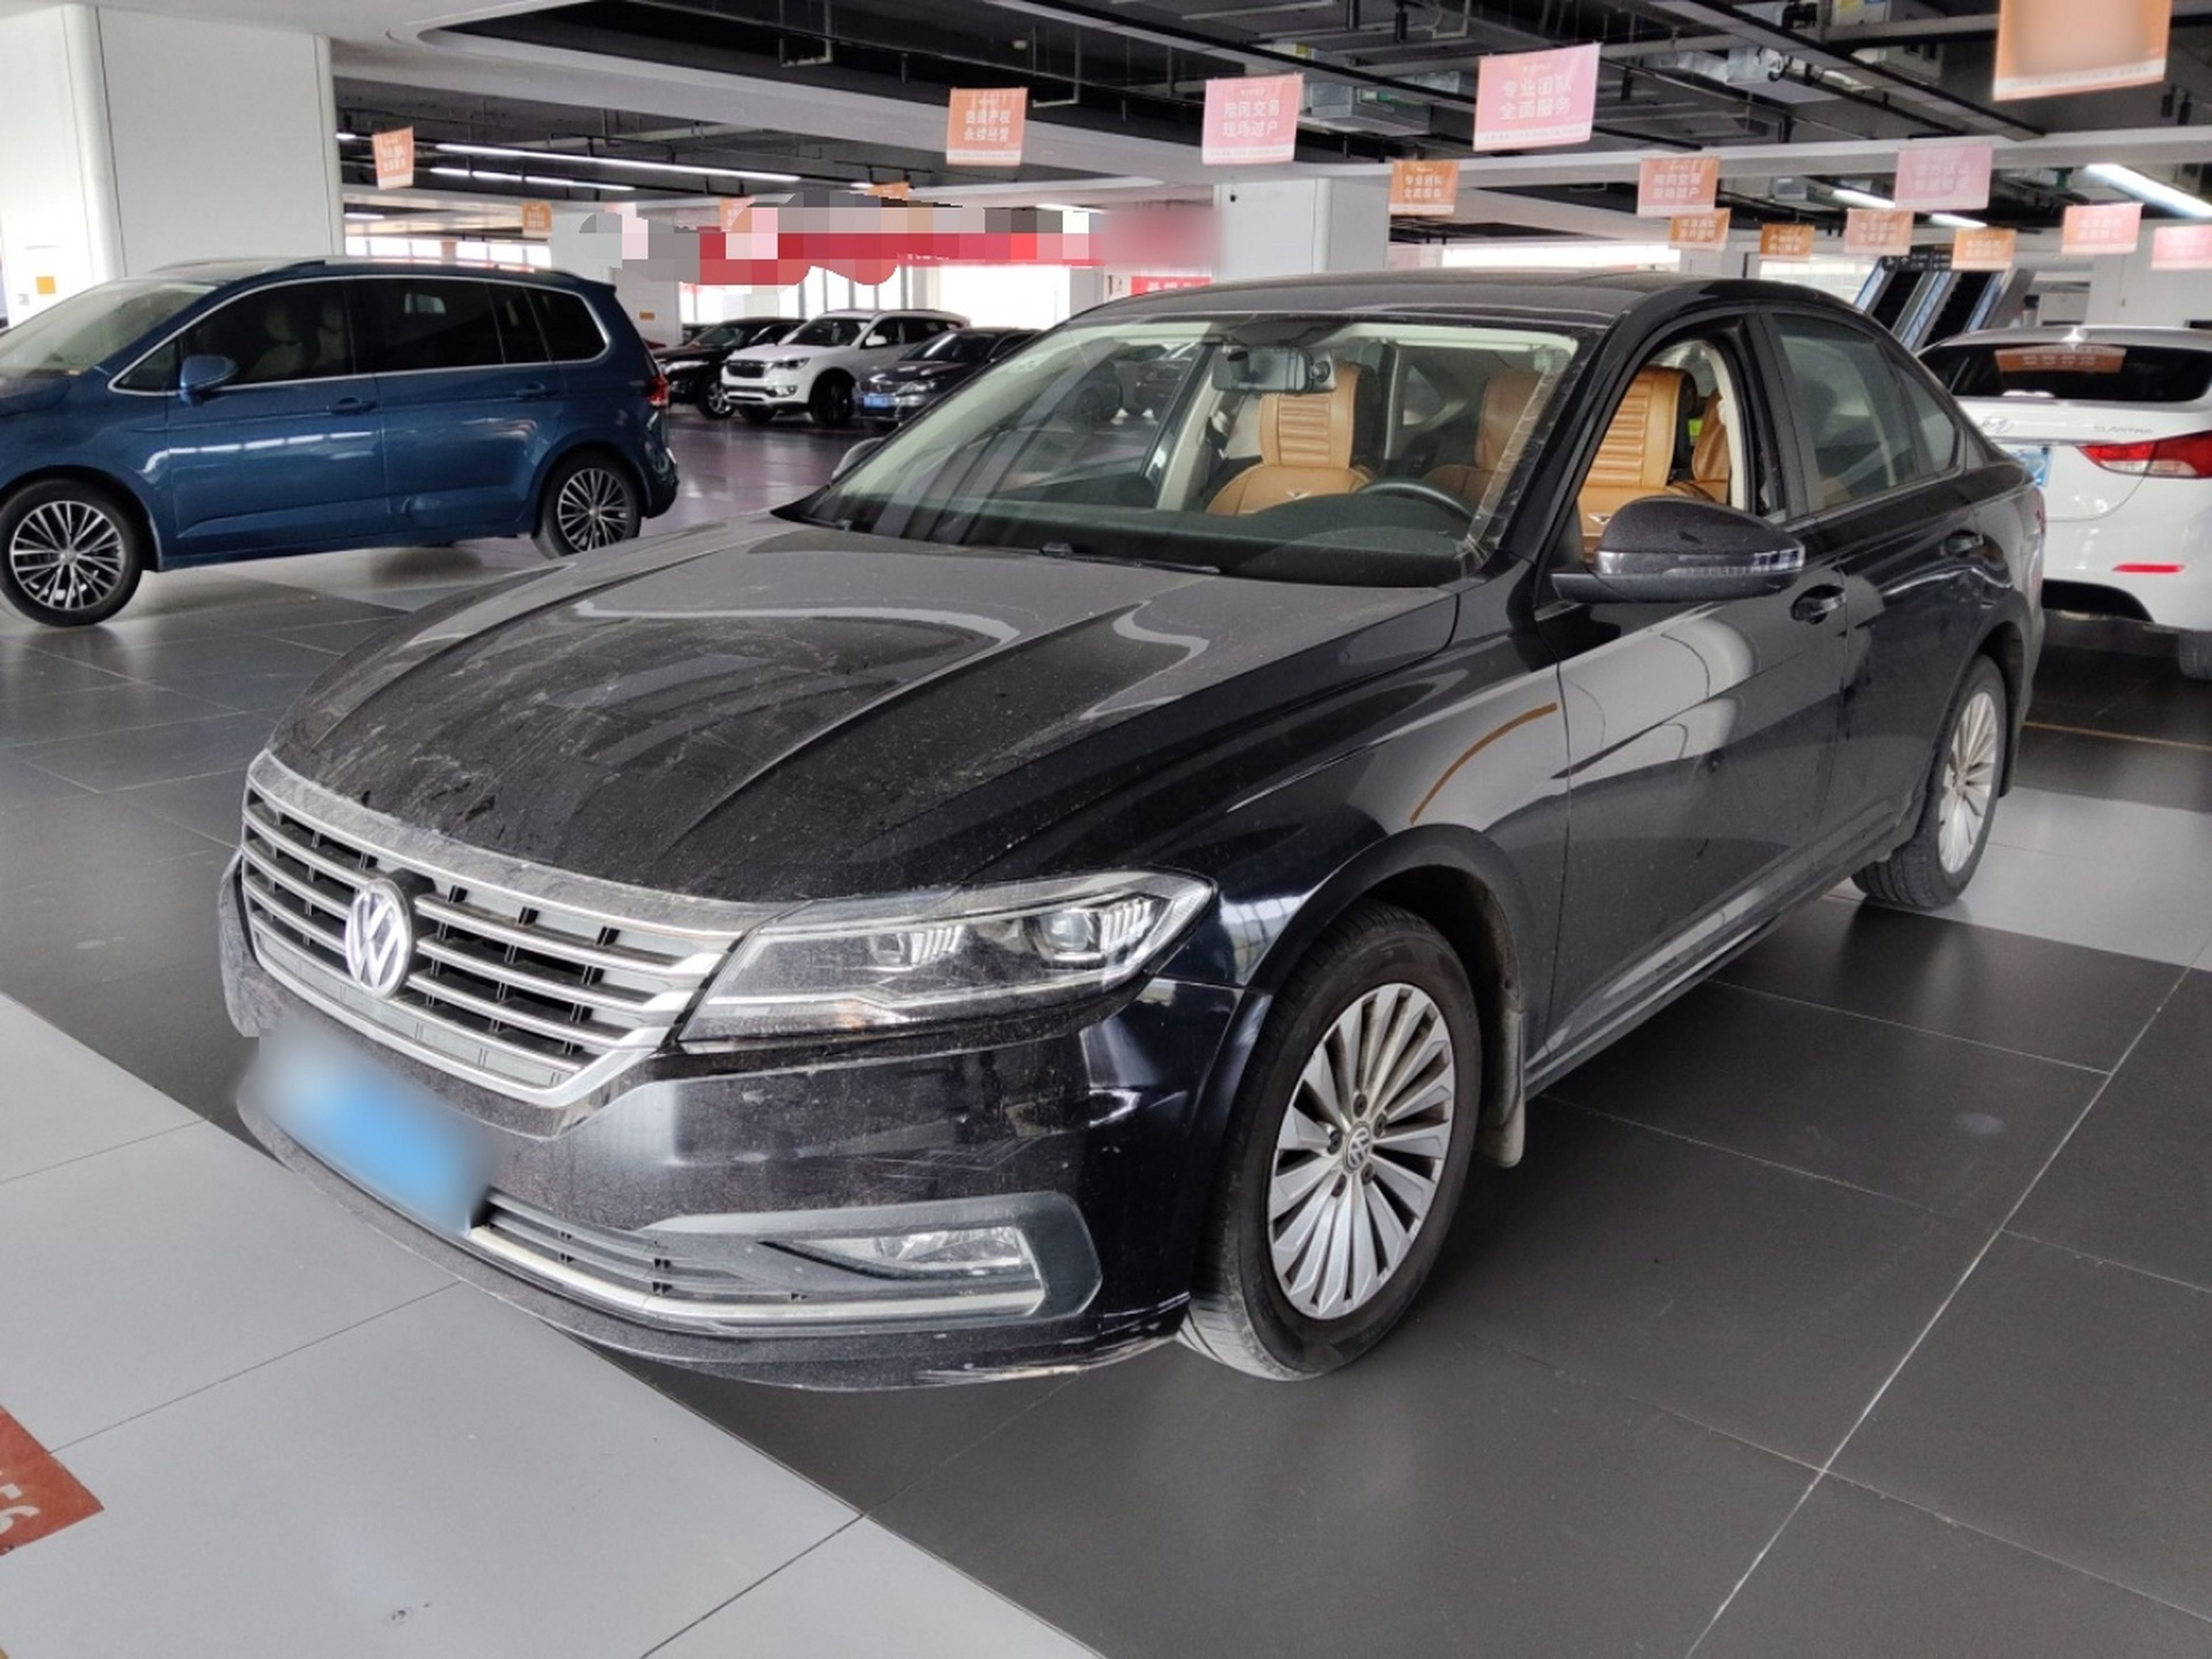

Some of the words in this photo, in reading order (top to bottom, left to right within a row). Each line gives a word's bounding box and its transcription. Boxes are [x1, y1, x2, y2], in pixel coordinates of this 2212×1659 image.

[1498, 75, 1571, 98] 专业团队
[1498, 97, 1570, 120] 全面服务
[1223, 120, 1278, 137] 现场过户
